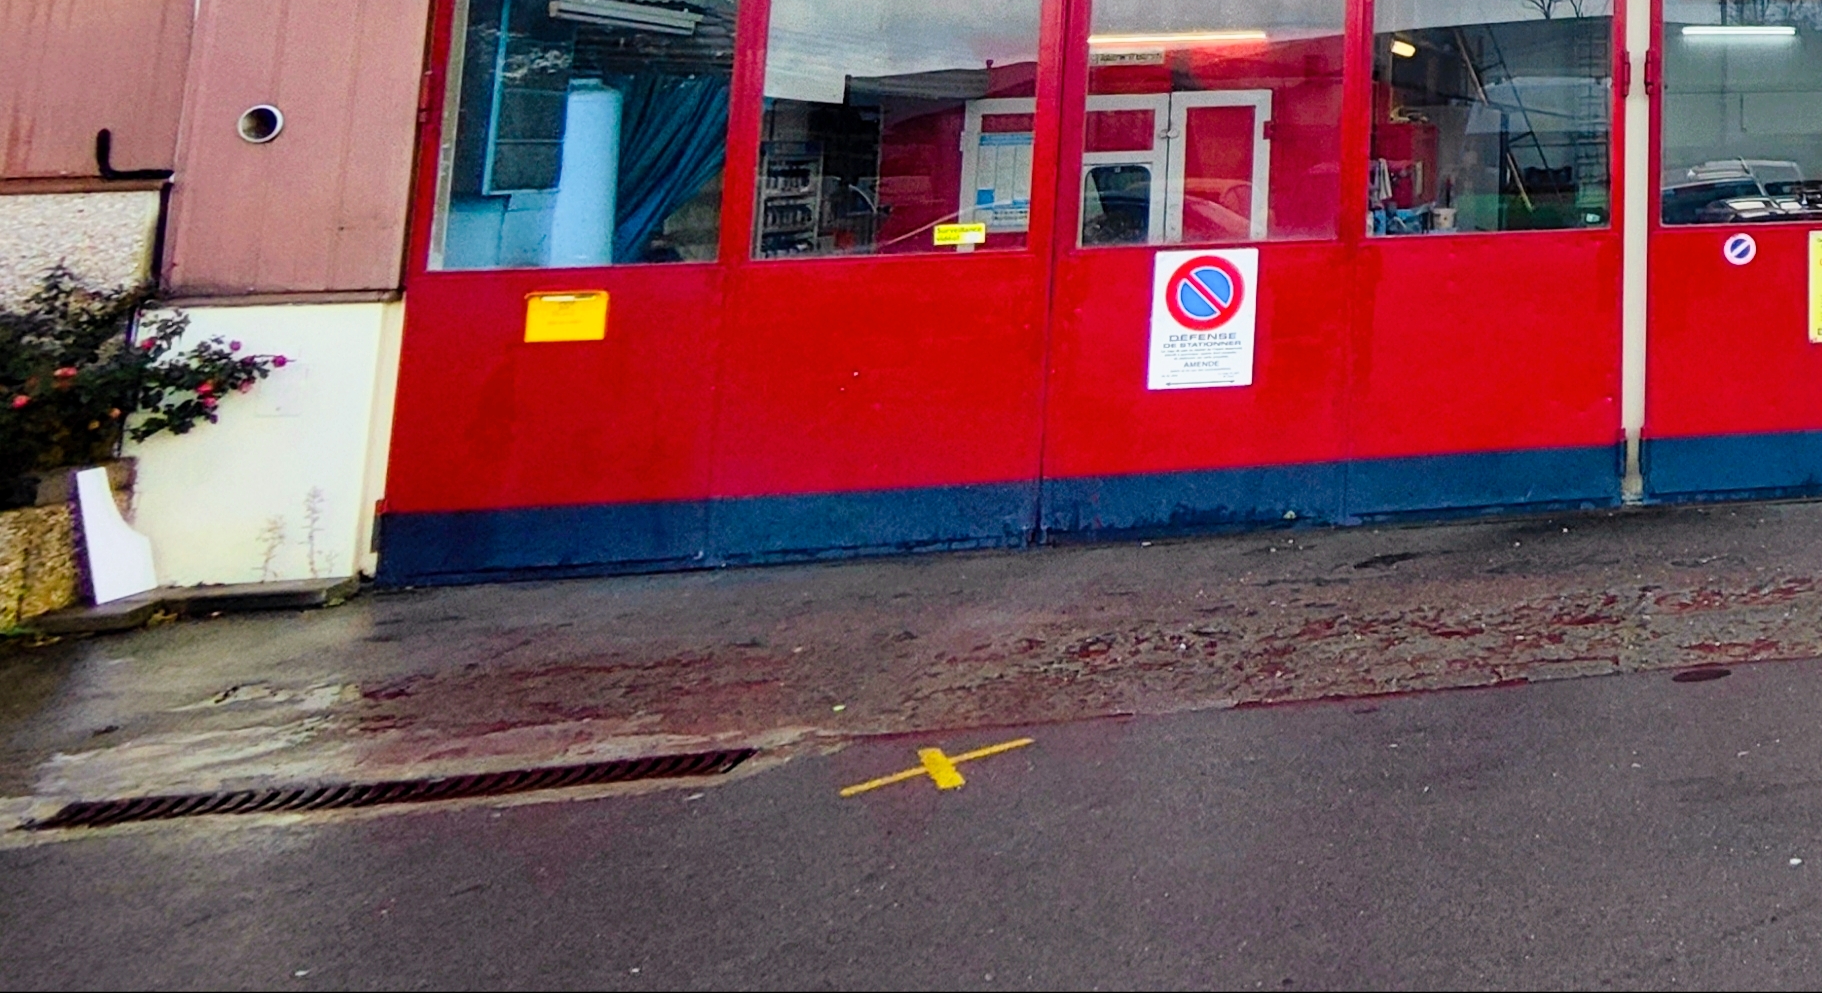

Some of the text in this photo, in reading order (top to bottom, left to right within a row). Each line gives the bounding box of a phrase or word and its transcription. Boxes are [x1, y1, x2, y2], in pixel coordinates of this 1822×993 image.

[937, 226, 982, 234] Surveillance
[1180, 340, 1241, 349] STATIONNER
[1183, 360, 1221, 368] AMENDE
